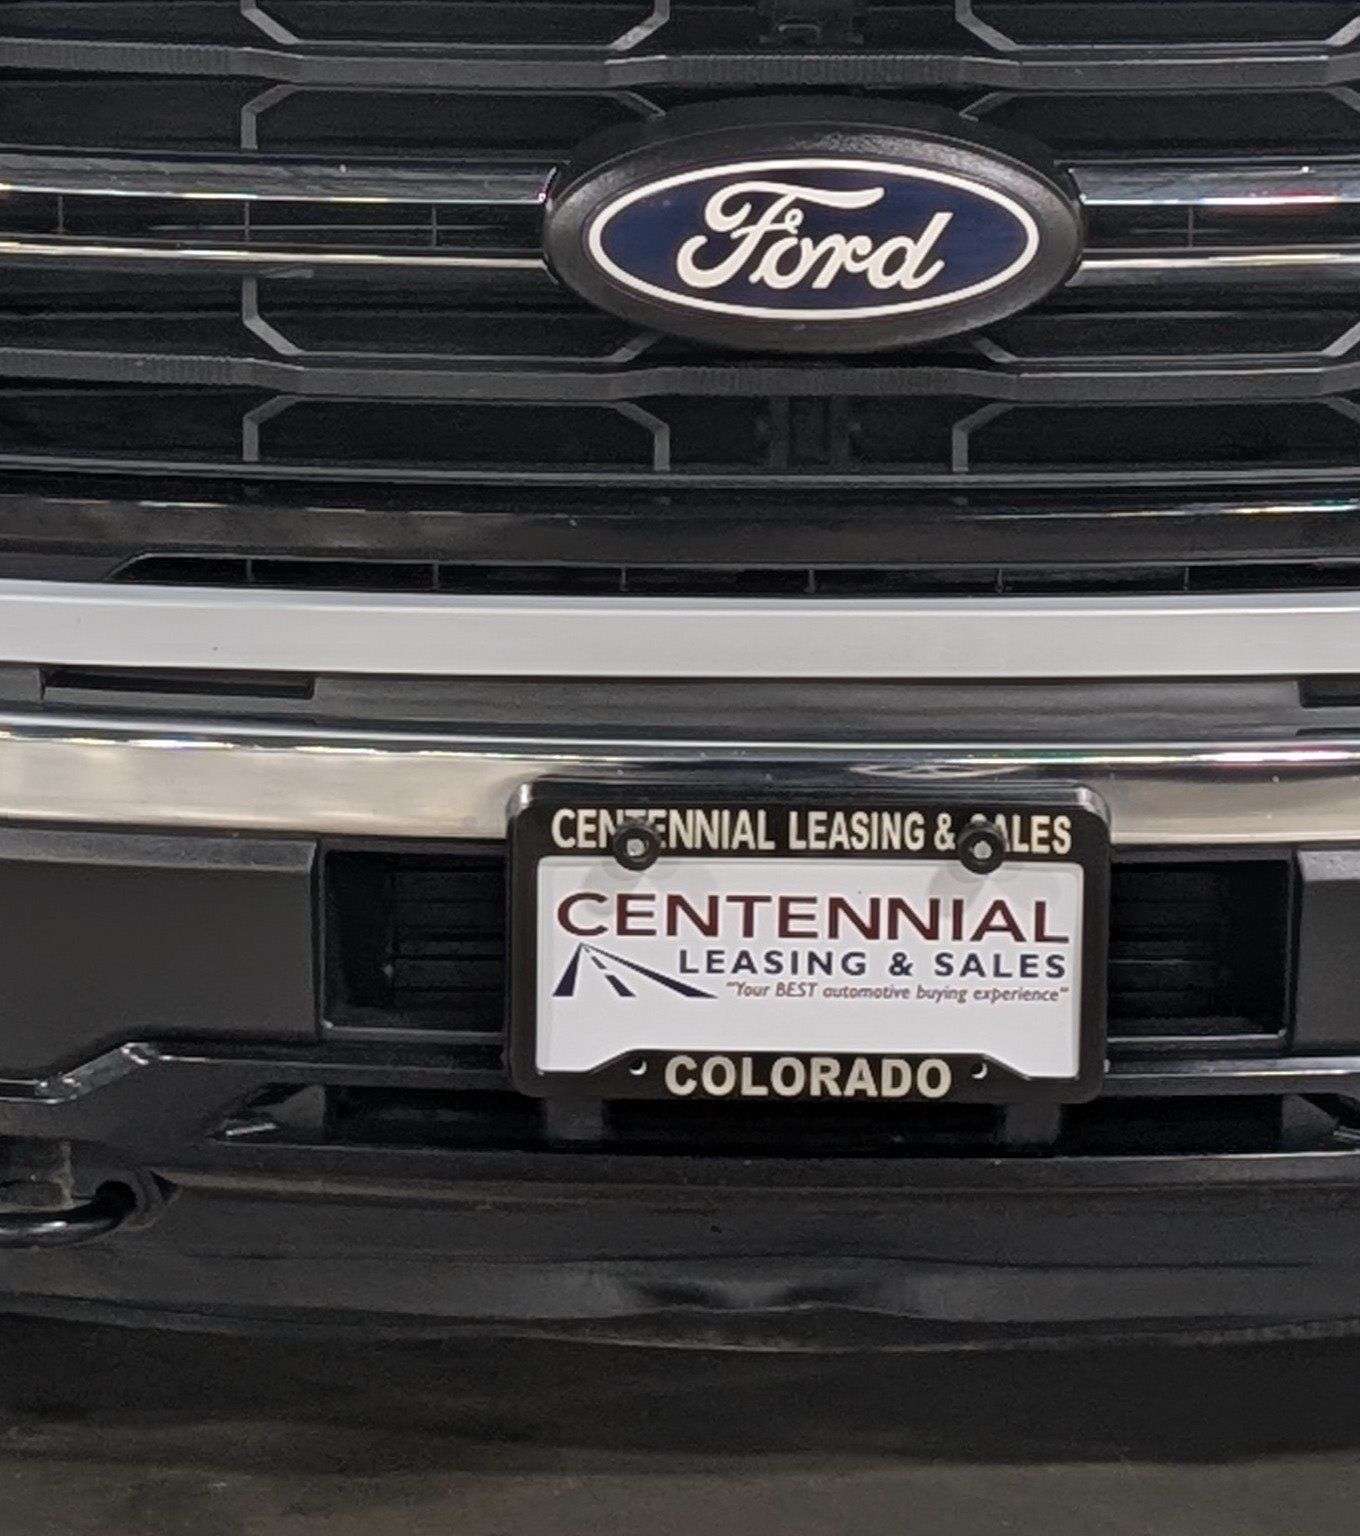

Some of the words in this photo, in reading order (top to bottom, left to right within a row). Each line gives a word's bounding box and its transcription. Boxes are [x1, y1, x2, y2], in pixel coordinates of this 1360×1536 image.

[676, 180, 954, 291] Ford
[789, 810, 926, 851] LEASING
[933, 812, 957, 851] &
[967, 812, 1072, 855] ALES
[556, 891, 1070, 943] CENTENNIAL
[679, 949, 866, 977] LEASING
[888, 952, 914, 977] &
[934, 953, 1067, 979] SALES
[775, 982, 818, 998] BEST
[822, 983, 911, 999] automotive
[915, 985, 968, 1003] buying
[664, 1055, 952, 1099] COLORADO
